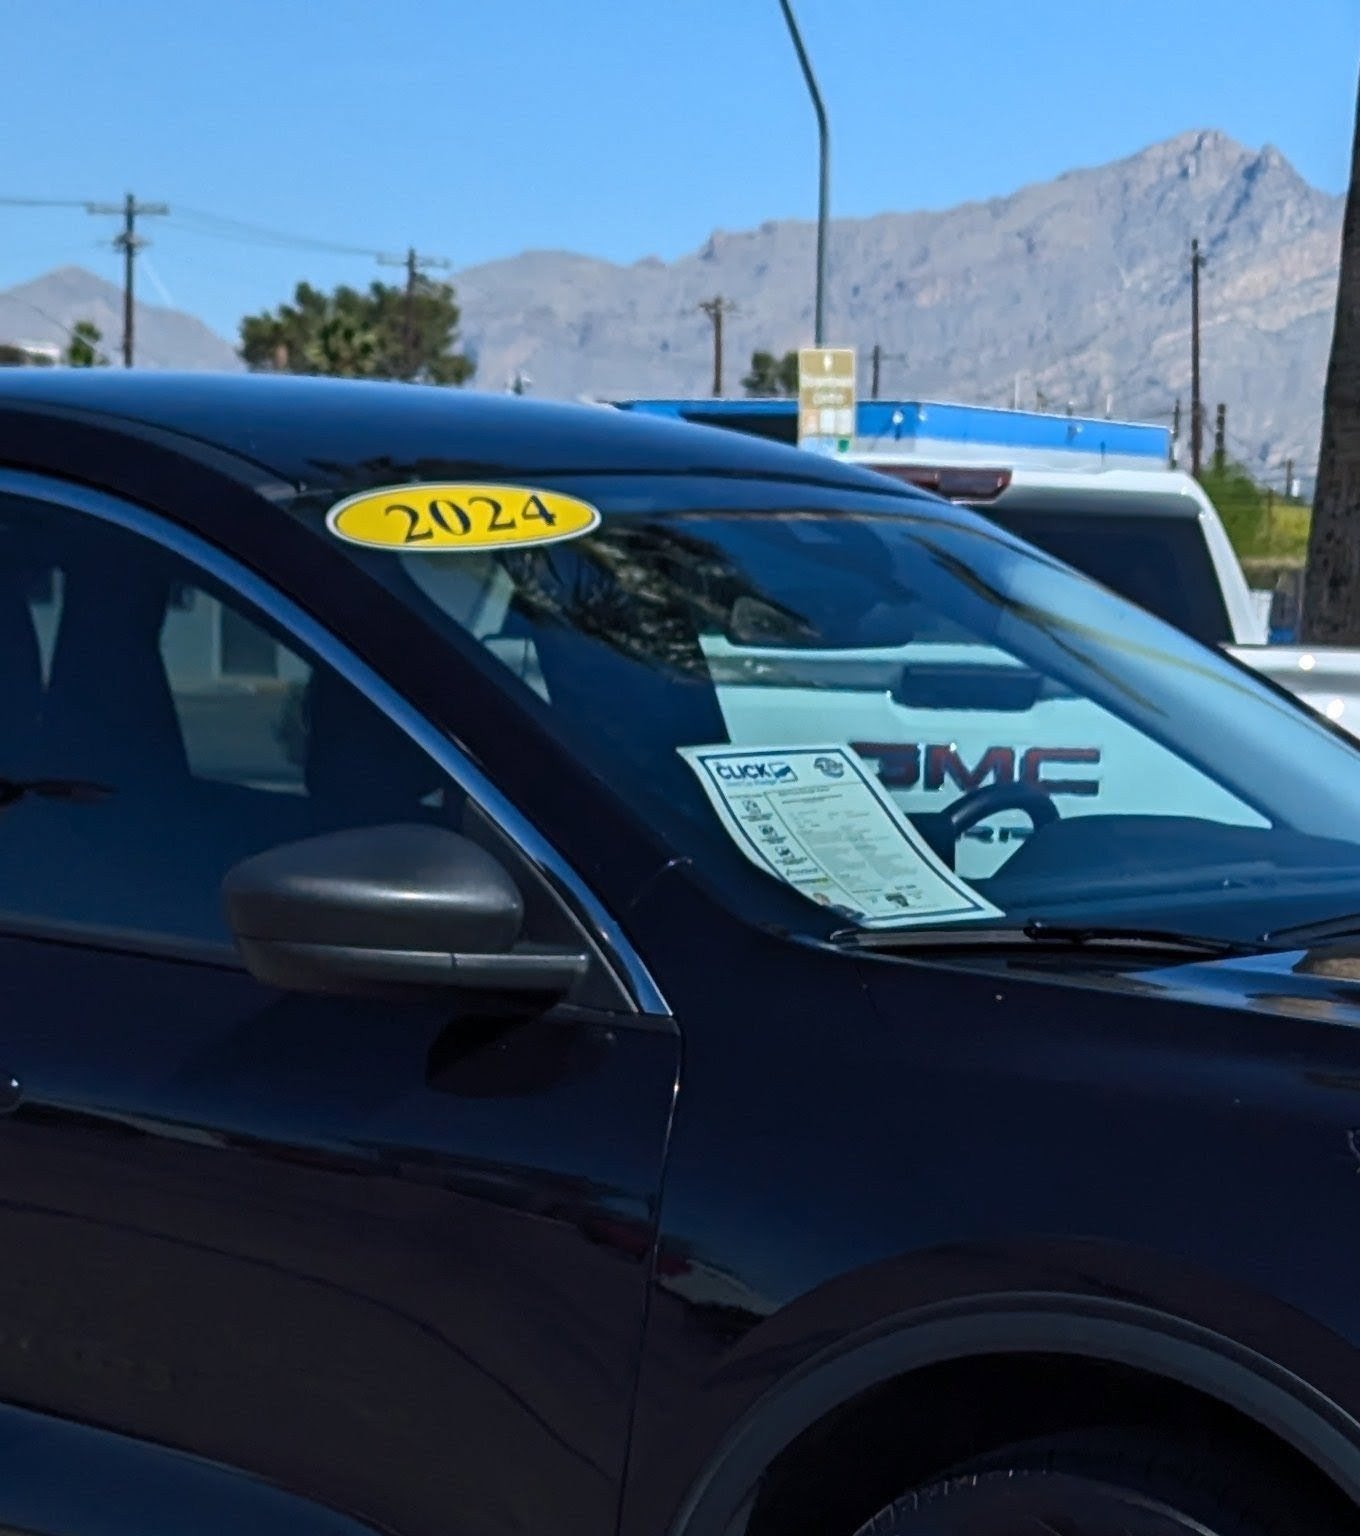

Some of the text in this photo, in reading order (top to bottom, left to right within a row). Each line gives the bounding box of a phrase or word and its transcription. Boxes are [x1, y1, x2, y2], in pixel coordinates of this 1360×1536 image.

[385, 494, 557, 543] 2024
[716, 763, 771, 780] CLICK
[848, 742, 1100, 798] GMC
